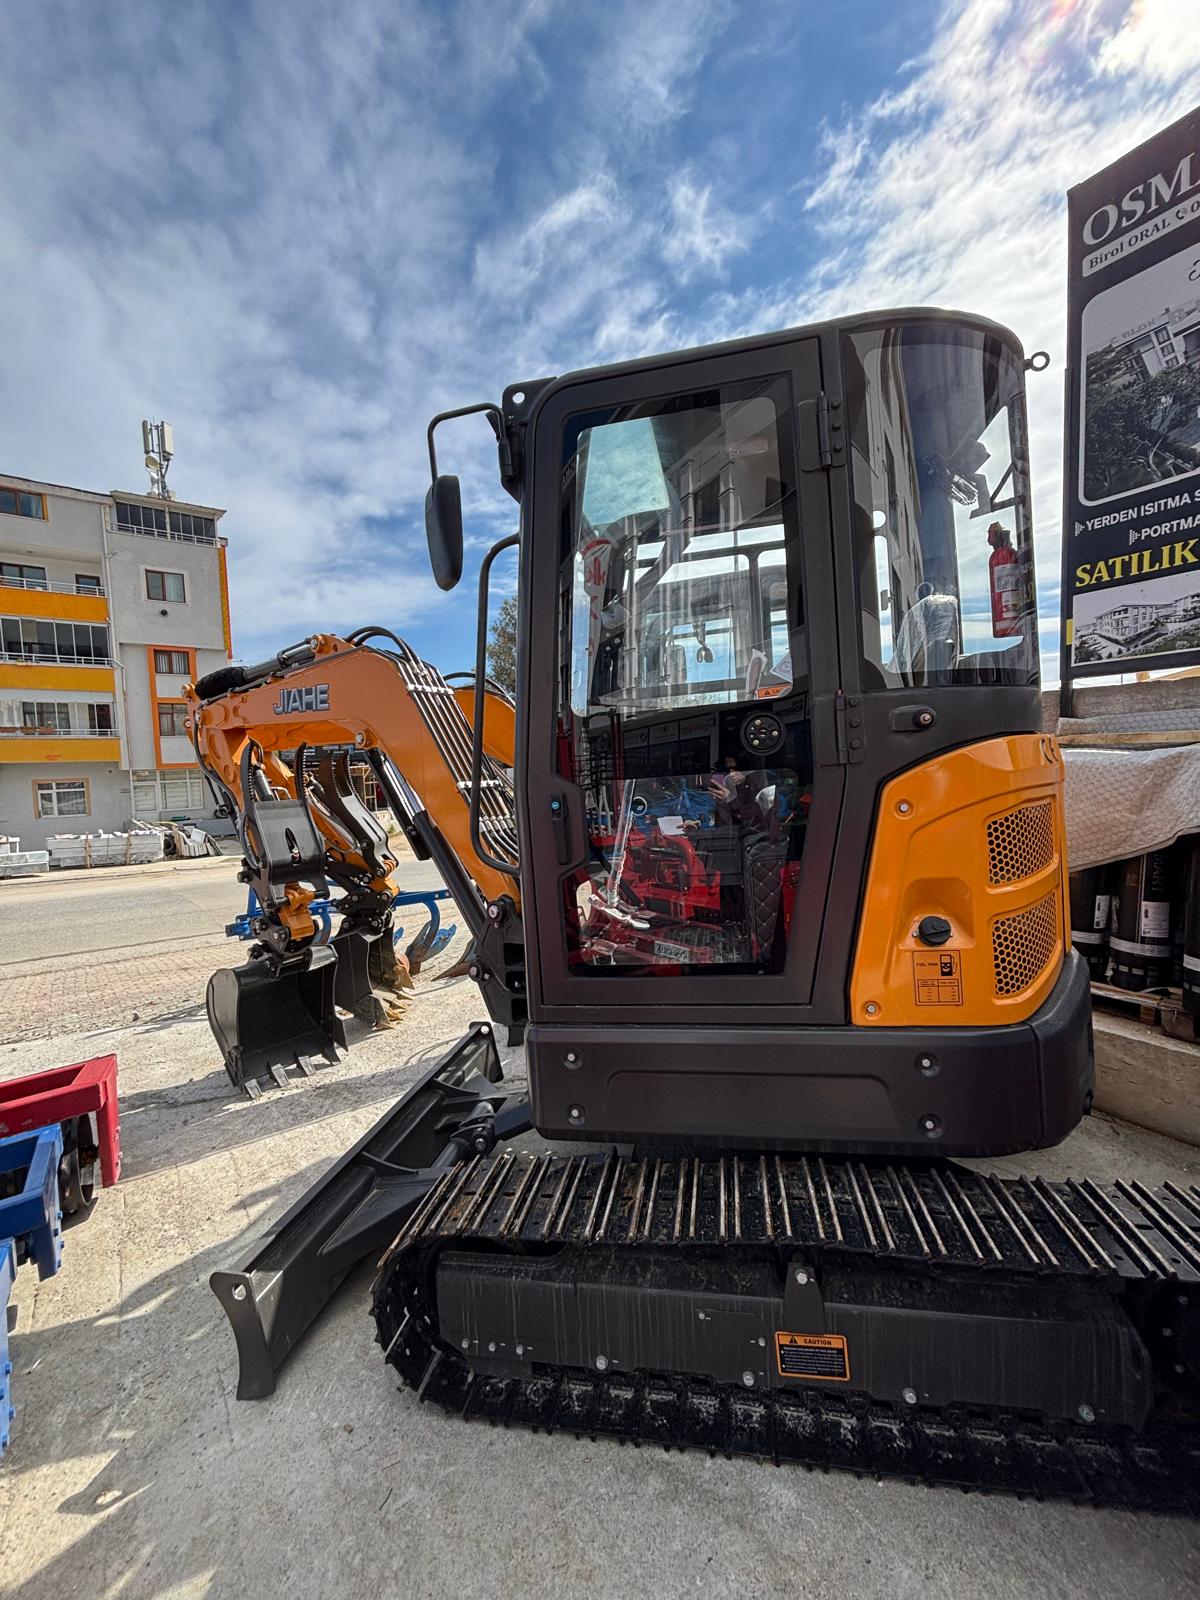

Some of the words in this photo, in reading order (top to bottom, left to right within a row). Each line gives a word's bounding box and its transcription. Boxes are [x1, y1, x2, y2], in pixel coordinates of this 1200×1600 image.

[1089, 241, 1124, 269] Birol
[1128, 219, 1171, 247] ORAL
[1085, 507, 1138, 531] YERDEN
[1140, 493, 1191, 517] ISITMA
[1076, 539, 1200, 588] SATILIK
[273, 683, 330, 715] JIAHE
[803, 1338, 832, 1346] CAUTION
